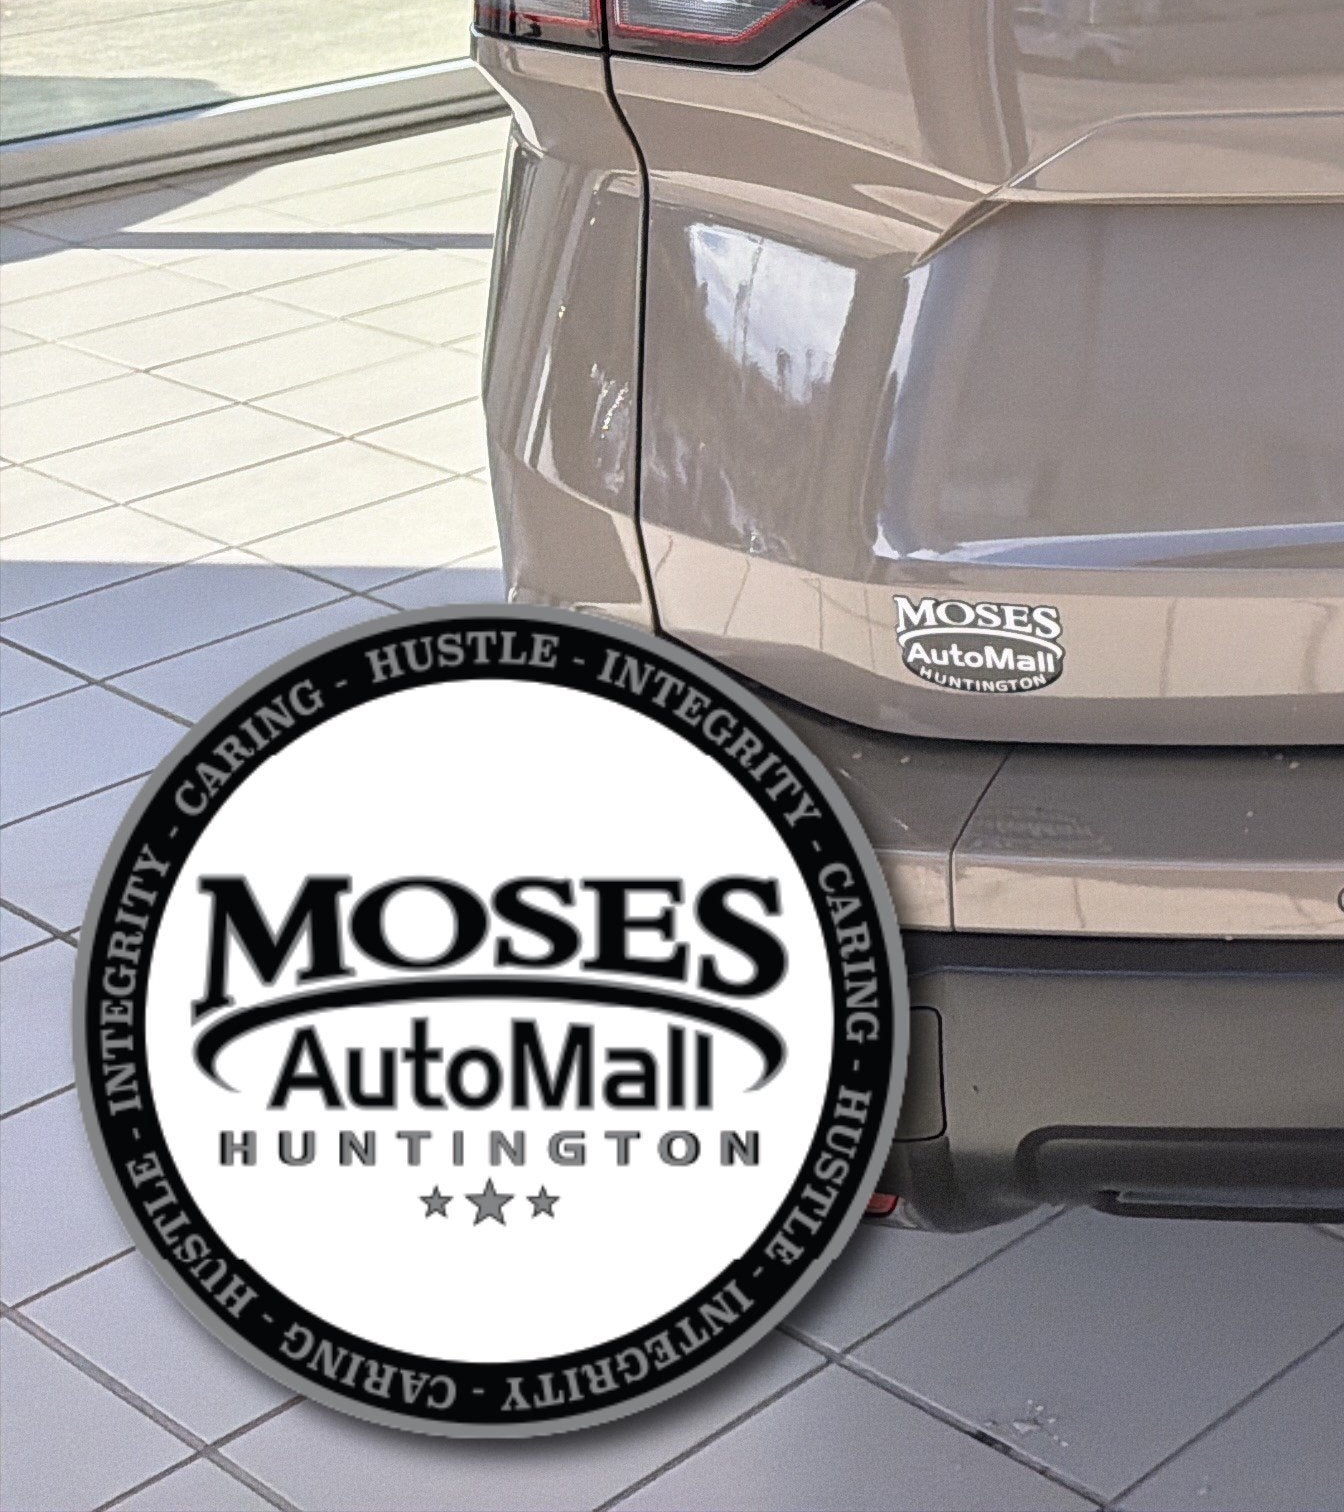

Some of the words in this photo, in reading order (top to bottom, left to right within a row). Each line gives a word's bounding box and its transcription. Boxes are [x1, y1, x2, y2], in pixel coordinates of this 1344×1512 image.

[892, 594, 1062, 639] MOSES
[906, 641, 1055, 673] AutoMall
[919, 665, 1047, 693] HUNTINGTON
